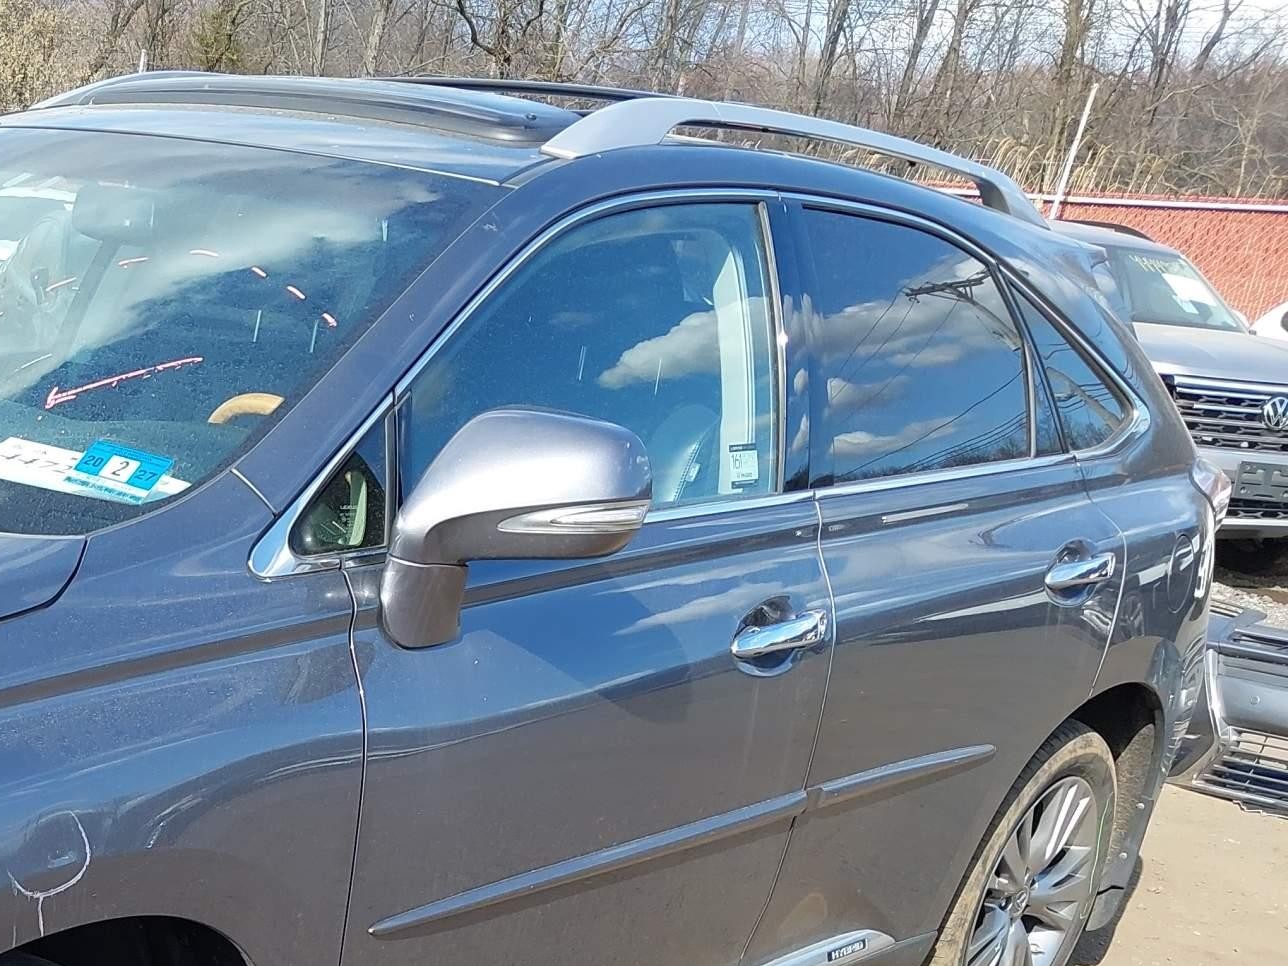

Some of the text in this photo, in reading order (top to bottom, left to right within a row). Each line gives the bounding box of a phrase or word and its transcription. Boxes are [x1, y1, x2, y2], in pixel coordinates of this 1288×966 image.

[83, 455, 103, 468] 20
[111, 460, 130, 477] 2
[133, 469, 157, 482] 27
